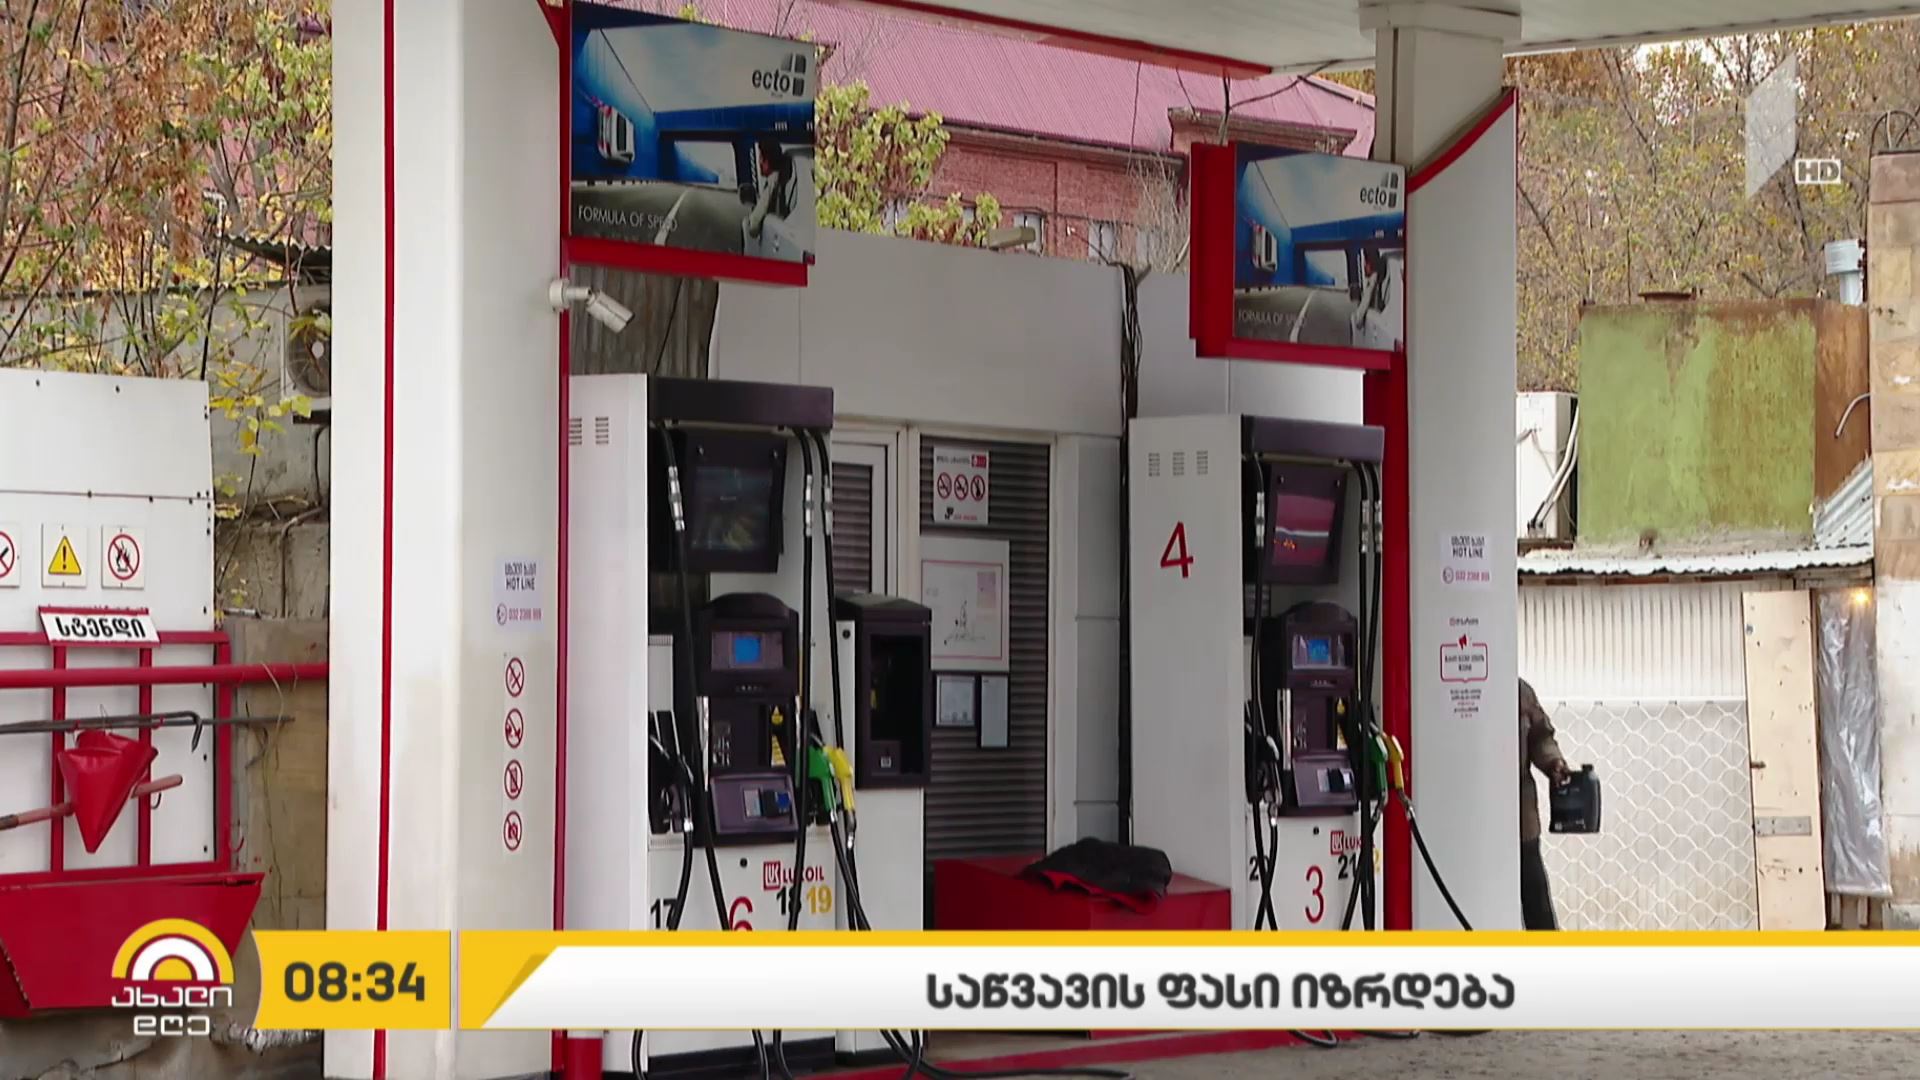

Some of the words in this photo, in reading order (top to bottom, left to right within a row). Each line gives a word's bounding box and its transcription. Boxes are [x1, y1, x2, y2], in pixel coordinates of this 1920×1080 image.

[751, 68, 791, 94] ecto
[1360, 186, 1388, 206] ecto
[577, 204, 628, 226] FORMULA
[629, 211, 645, 227] OF
[647, 214, 679, 232] SPED
[1160, 521, 1194, 578] 4
[505, 577, 520, 591] HOT
[521, 577, 535, 591] LINE
[55, 616, 146, 638] სტენდი
[783, 866, 825, 884] LUOIL
[806, 886, 832, 914] 19
[1305, 866, 1324, 924] 3
